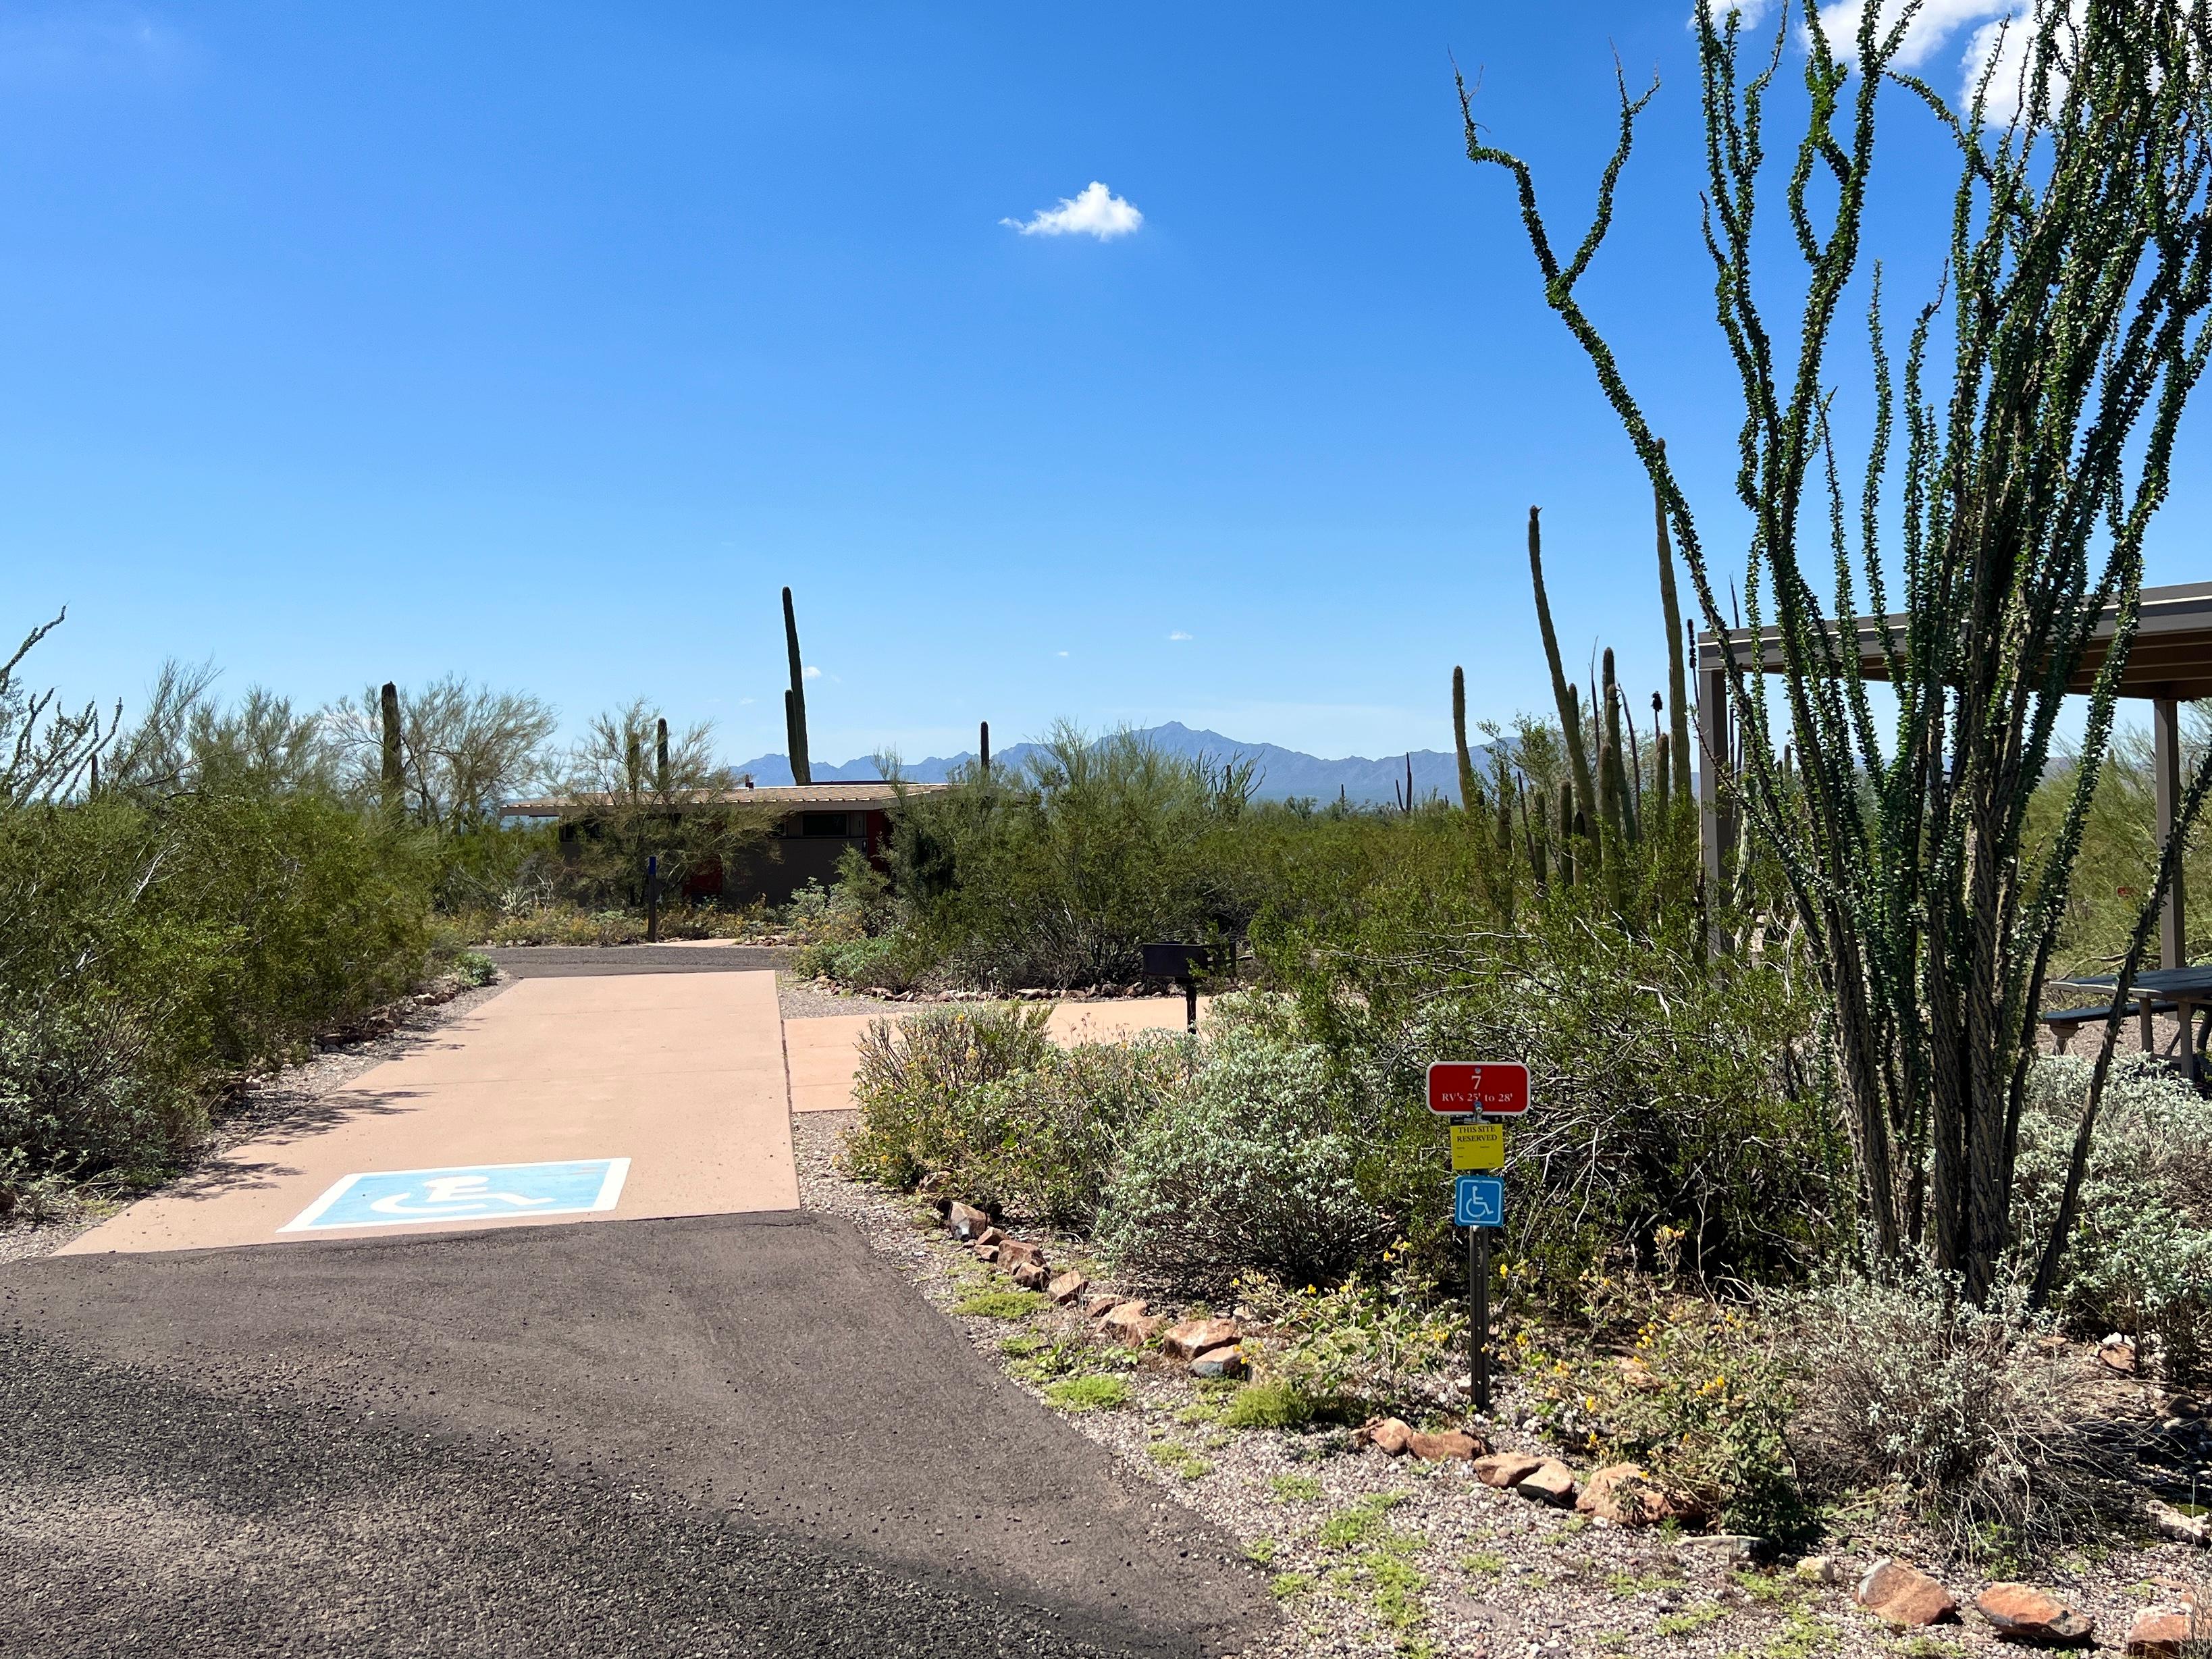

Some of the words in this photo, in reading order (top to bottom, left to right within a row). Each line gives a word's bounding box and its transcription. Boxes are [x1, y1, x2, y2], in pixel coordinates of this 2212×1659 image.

[1471, 1076, 1481, 1090] 7
[1442, 1092, 1464, 1102] RV's
[1467, 1093, 1481, 1102] 25'
[1485, 1094, 1495, 1102] to
[1498, 1094, 1513, 1102] 28'
